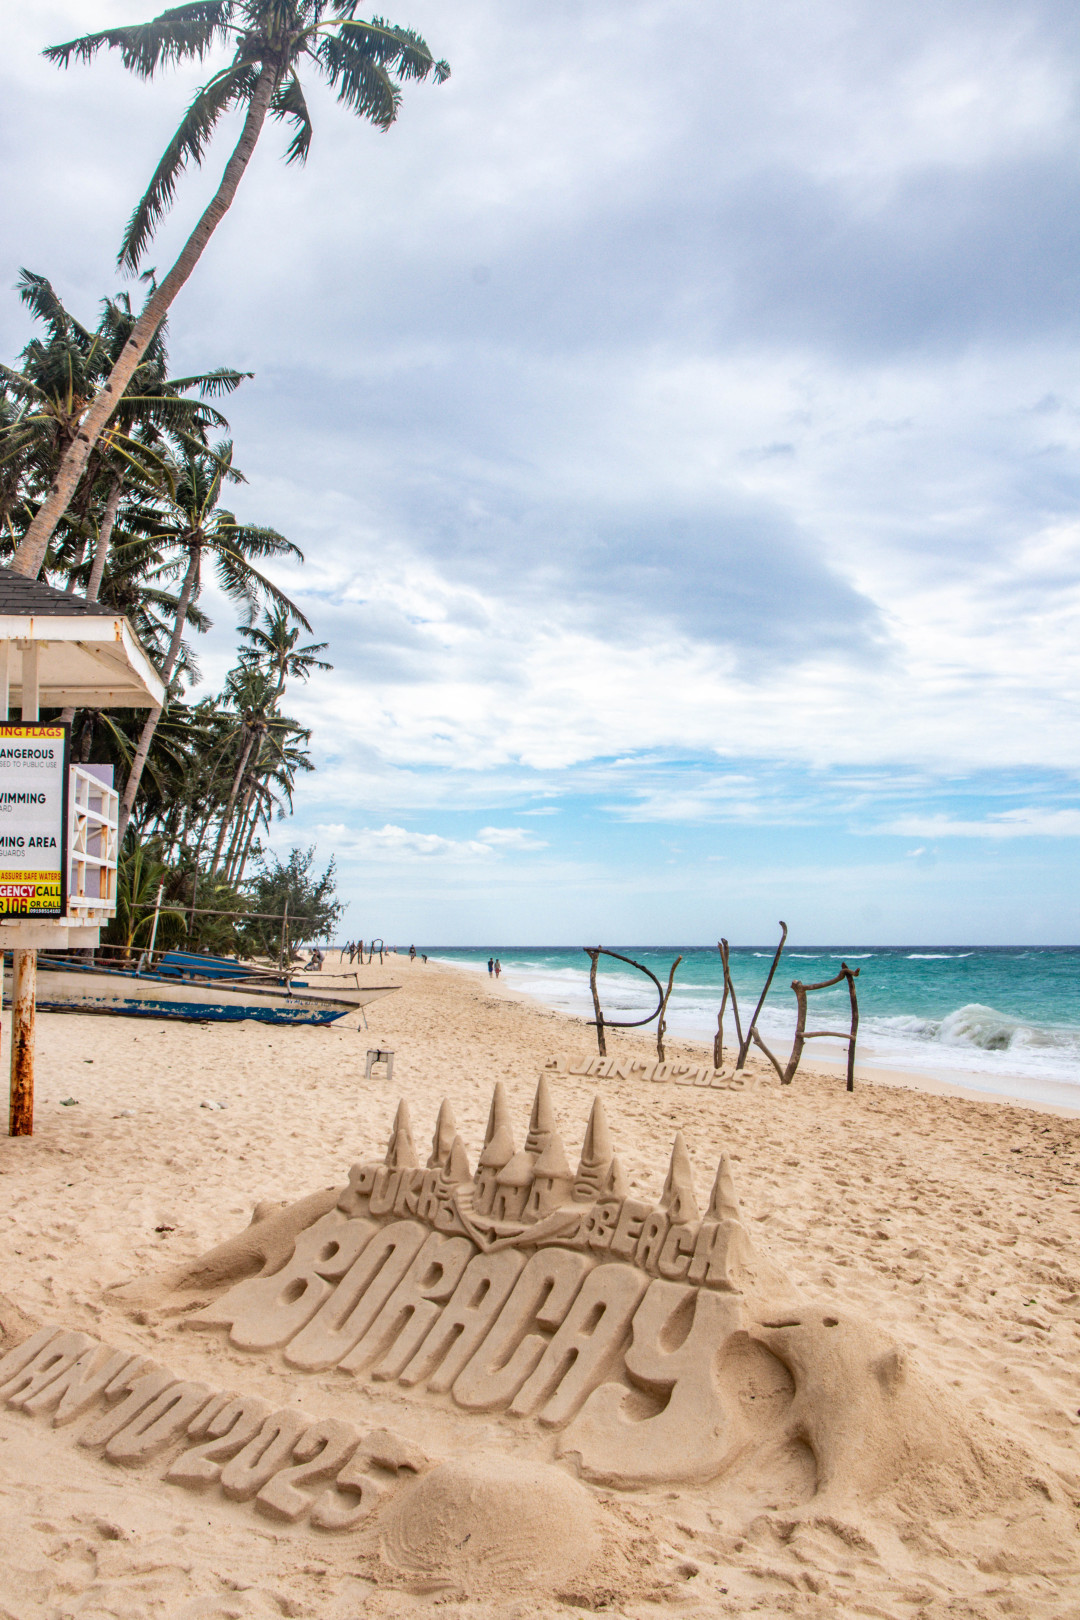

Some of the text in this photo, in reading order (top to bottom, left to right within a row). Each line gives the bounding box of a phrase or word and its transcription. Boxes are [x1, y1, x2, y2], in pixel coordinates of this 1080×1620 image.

[26, 727, 62, 737] FLAGS
[0, 749, 54, 759] ANGEROUS
[28, 836, 57, 848] AREA
[1, 872, 61, 880] ASSURE SAFE WATERS
[0, 885, 61, 897] GENCY CALL
[6, 898, 28, 913] 106
[30, 900, 41, 908] OR
[337, 1163, 742, 1289] PUKA BEACH
[190, 1219, 745, 1487] BORACAY
